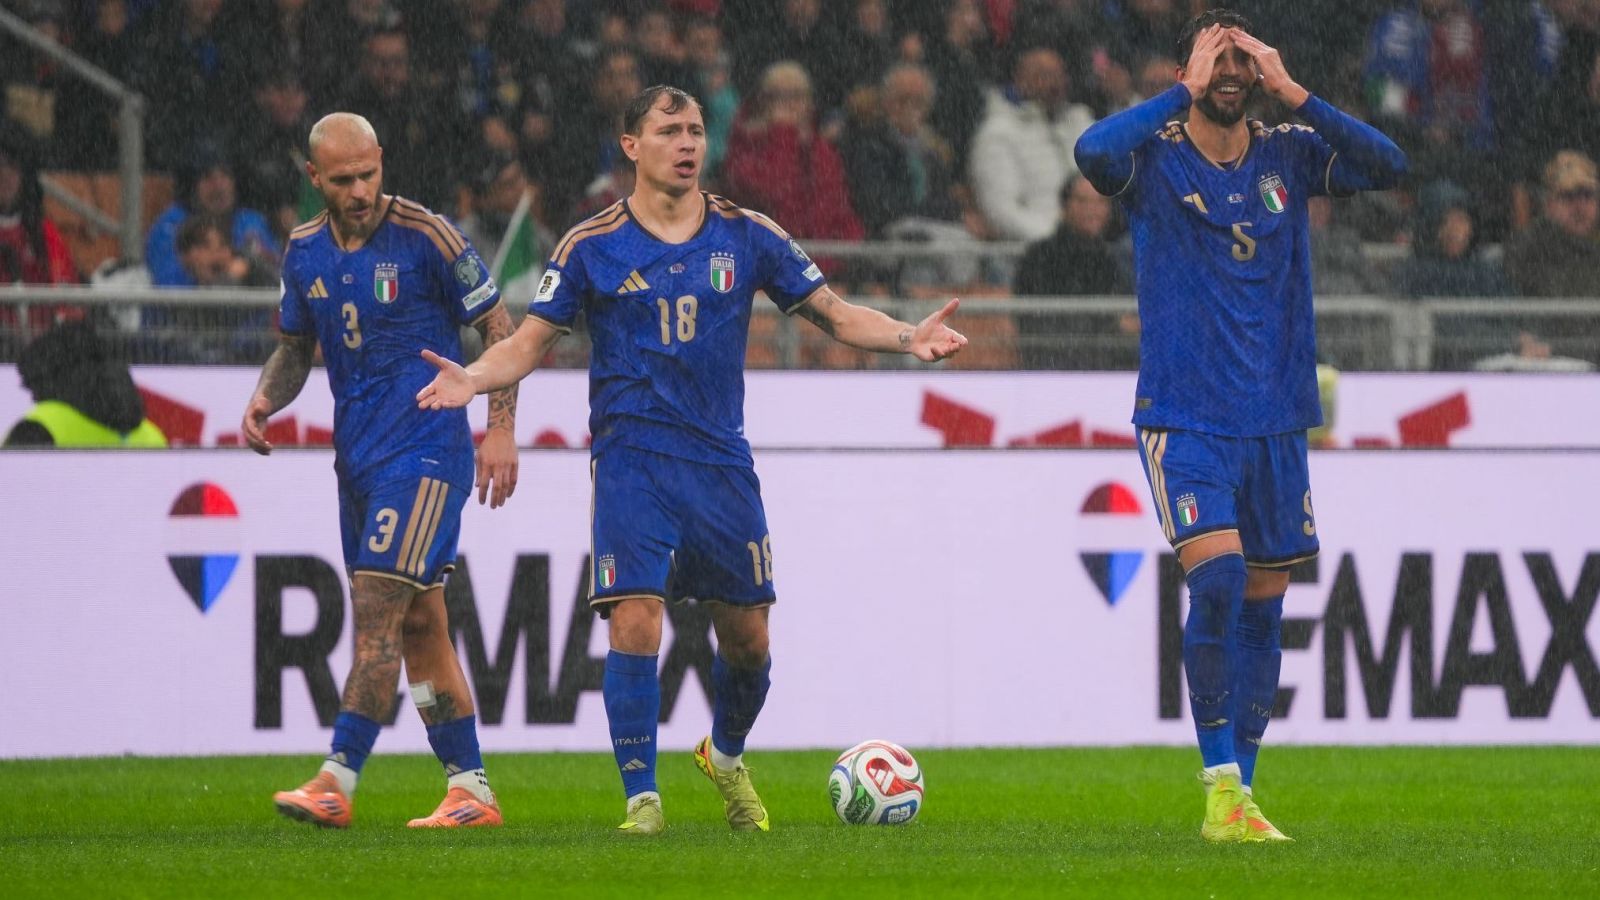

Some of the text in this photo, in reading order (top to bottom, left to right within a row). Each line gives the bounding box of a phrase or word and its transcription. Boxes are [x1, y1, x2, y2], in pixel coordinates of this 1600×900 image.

[1232, 221, 1256, 262] 5
[712, 259, 733, 269] ITALIA
[341, 302, 363, 349] 3
[656, 294, 698, 345] 18
[1178, 499, 1195, 508] ITALIA
[368, 507, 399, 553] 3
[254, 553, 722, 729] RMAX
[615, 735, 650, 747] ITALIA
